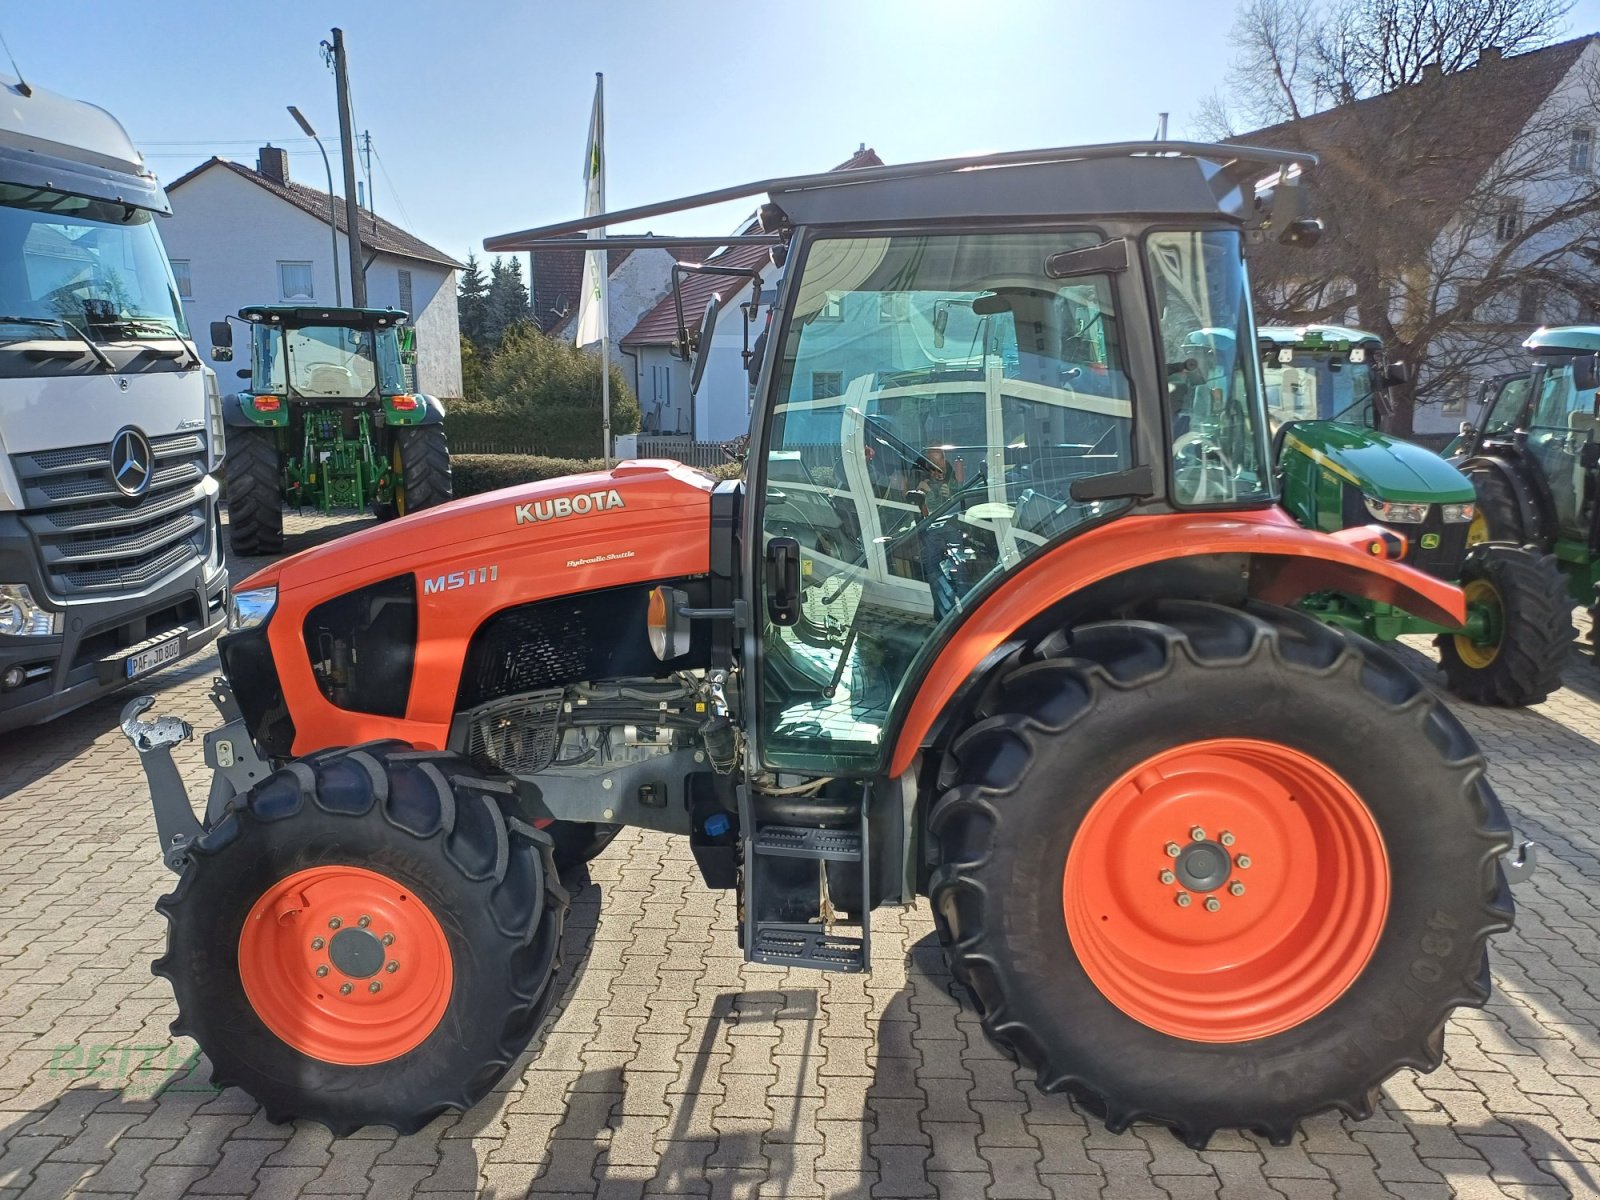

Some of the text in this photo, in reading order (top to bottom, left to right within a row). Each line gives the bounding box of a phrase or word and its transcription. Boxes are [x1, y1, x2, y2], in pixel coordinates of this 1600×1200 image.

[515, 489, 625, 525] KUBOTA
[566, 551, 635, 568] Hydraulic Shuttle
[423, 565, 498, 595] M5111
[133, 642, 178, 673] PAF JD 800
